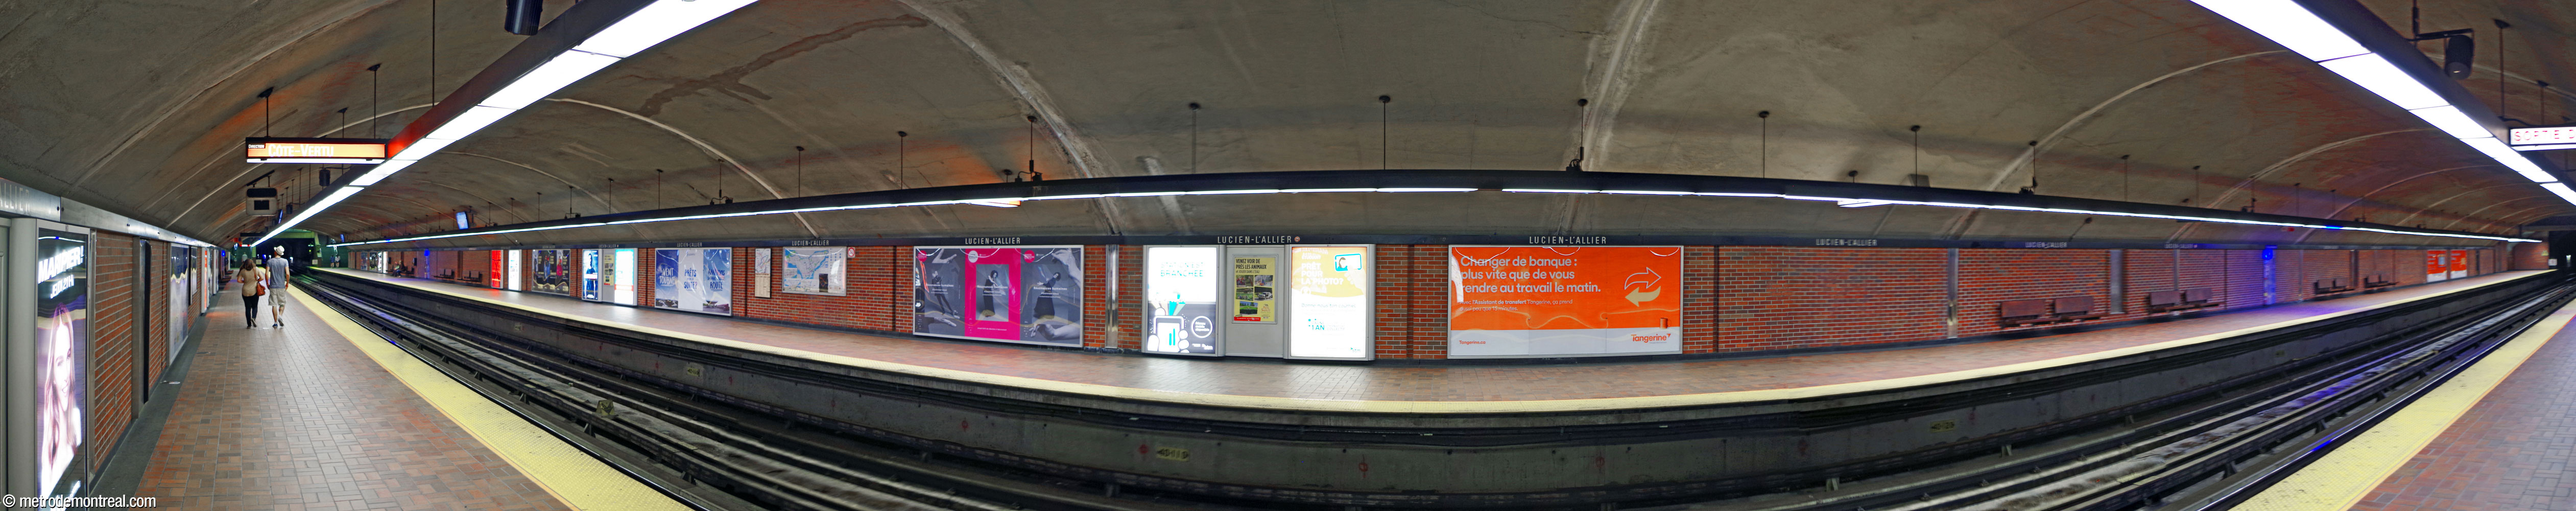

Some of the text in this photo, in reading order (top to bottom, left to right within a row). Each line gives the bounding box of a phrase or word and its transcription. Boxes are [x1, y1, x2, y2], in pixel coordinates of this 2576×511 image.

[1218, 236, 1292, 244] LUCIEN-L'ALLIER
[1529, 236, 1607, 244] LUCIEN-L'ALLIER
[1301, 262, 1321, 270] PRÊT
[1460, 256, 1509, 269] Changer
[1512, 256, 1527, 266] de
[1529, 256, 1572, 269] banque
[1461, 269, 1575, 282] plus vite que de vous
[1462, 282, 1602, 293] rendre au travail le matin.
[1631, 334, 1667, 343] Tangerine
